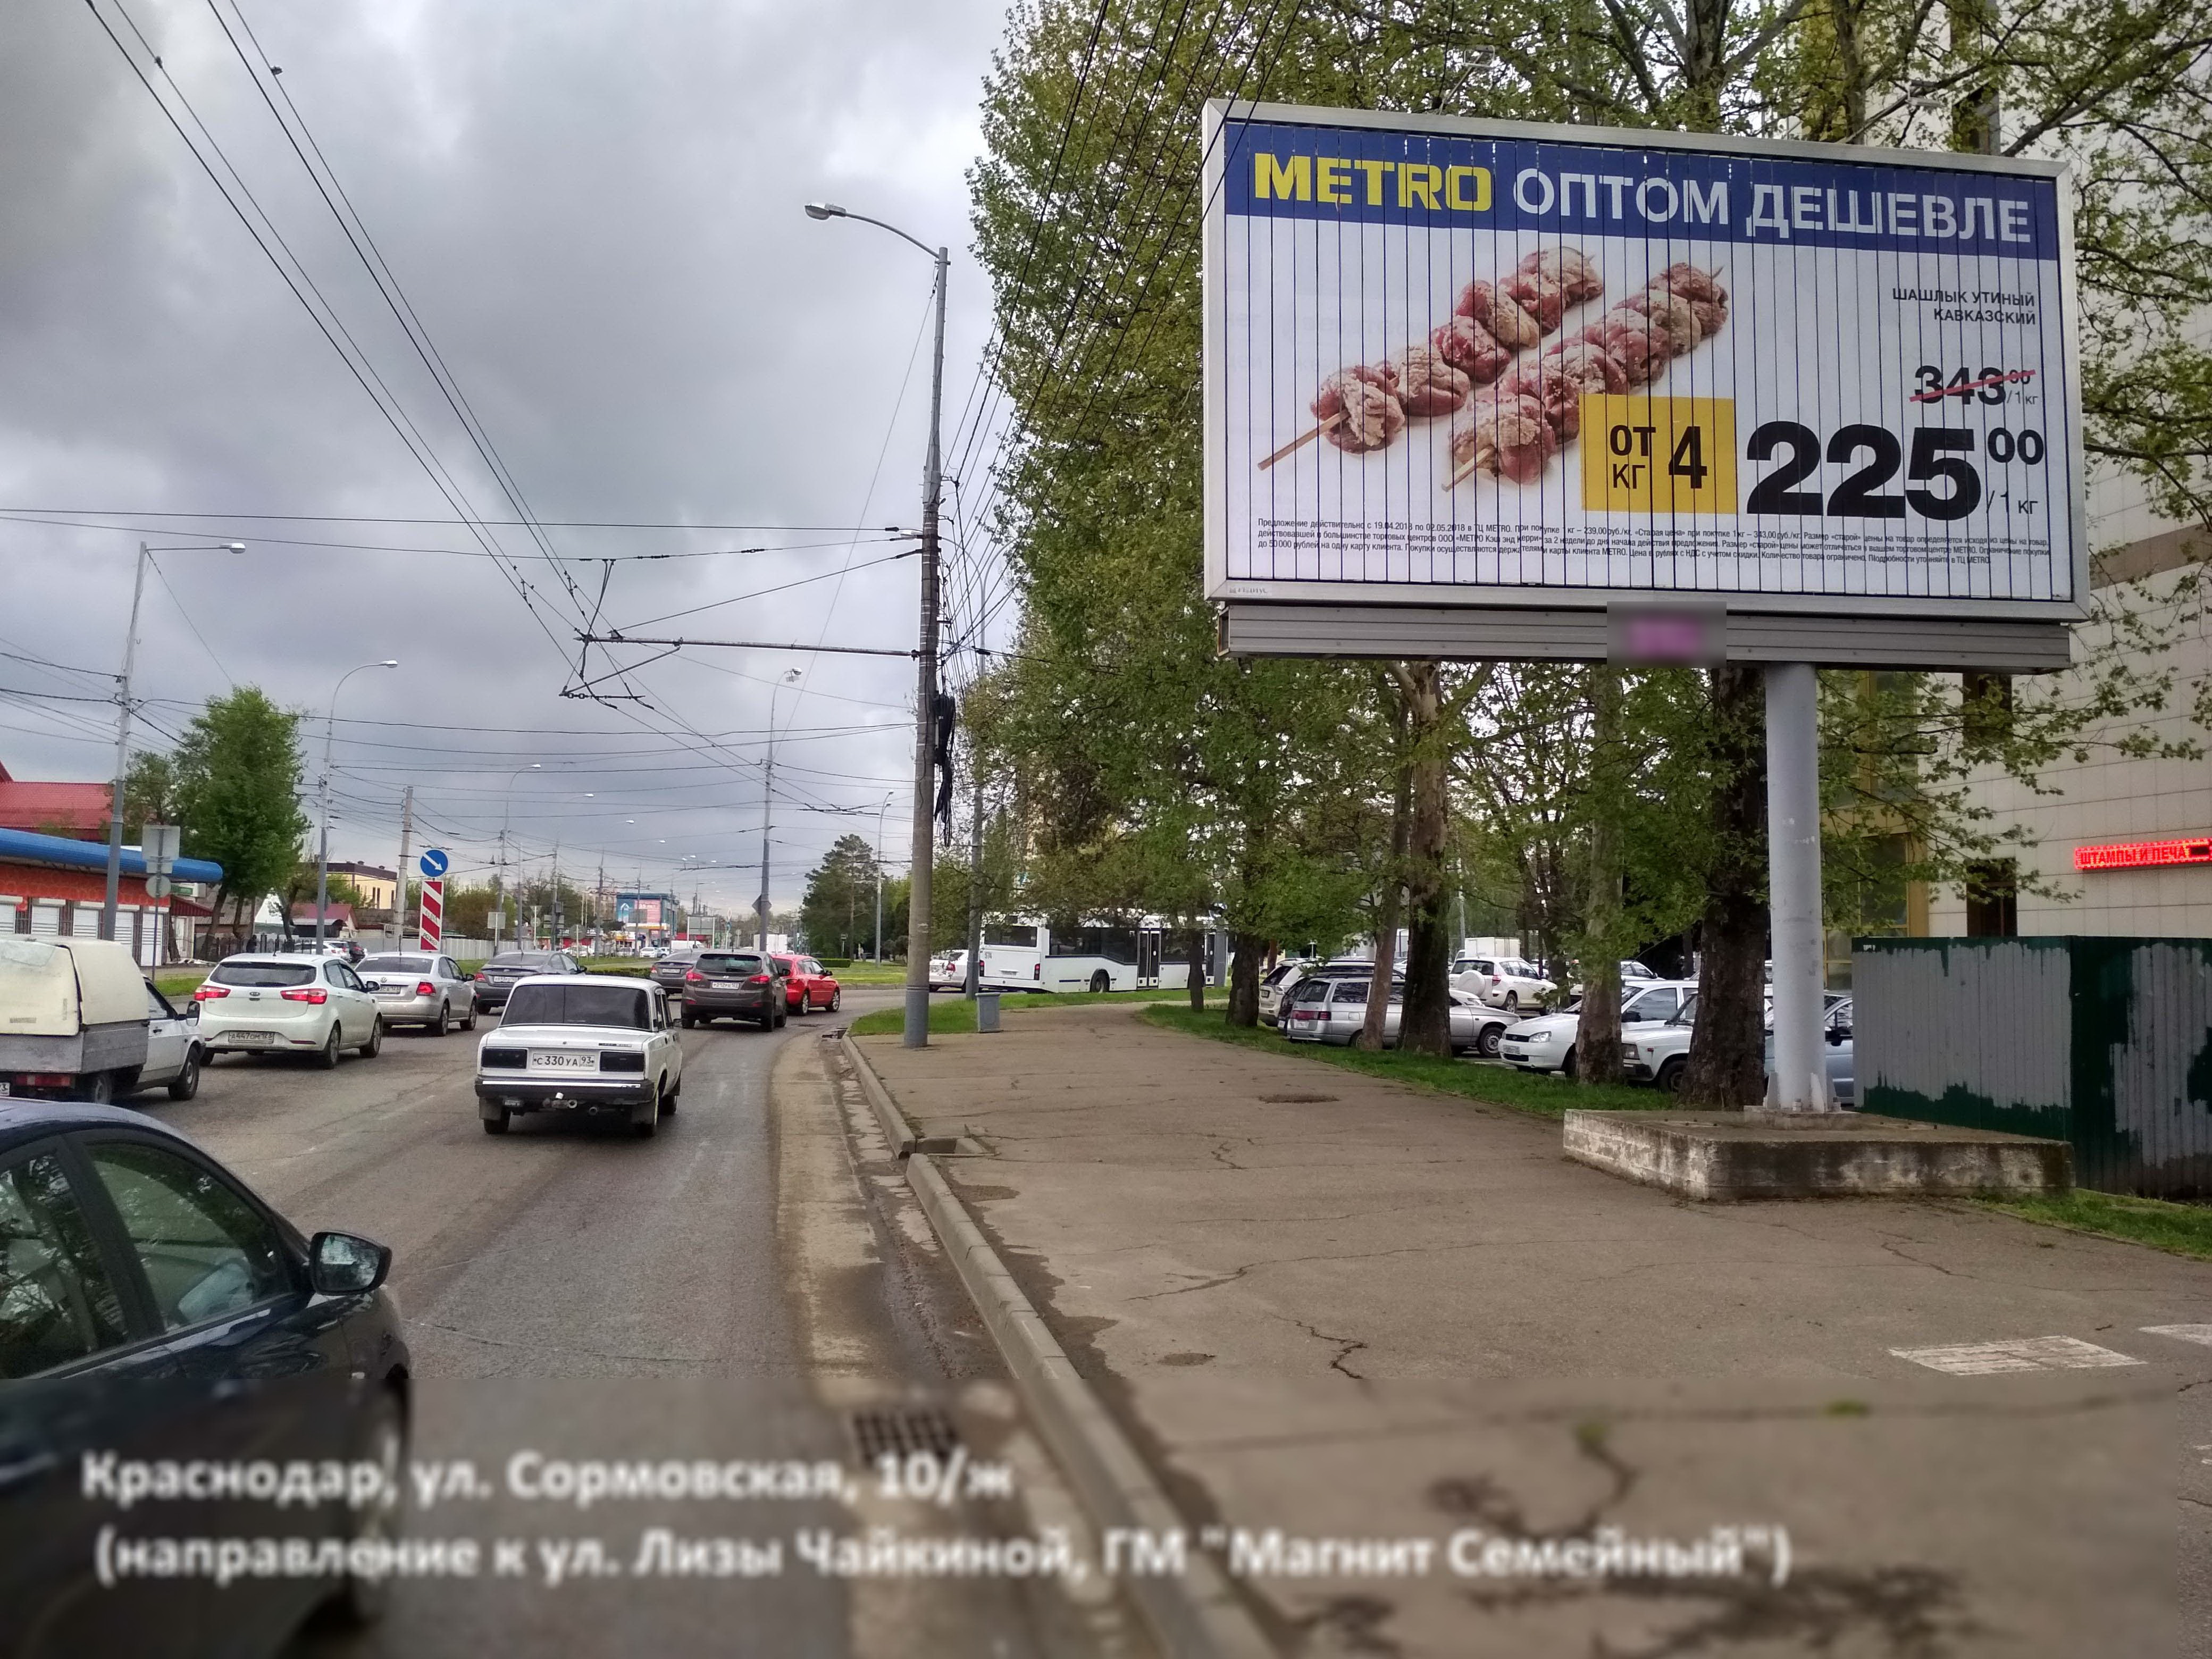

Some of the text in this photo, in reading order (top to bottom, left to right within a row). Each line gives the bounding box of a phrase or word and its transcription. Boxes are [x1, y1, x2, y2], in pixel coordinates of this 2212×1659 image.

[1254, 152, 2031, 243] METRO ОПТОМ ДЕШЕВЛЕ
[1892, 288, 2034, 307] ШАШЛЫК УТИНЫЙ
[1934, 308, 2036, 325] КАВКАЗСКИЙ
[1610, 424, 1656, 457] ОТ
[1669, 425, 1708, 489] 4
[1613, 464, 1646, 489] КГ
[1747, 421, 2045, 521] 225 00
[1258, 518, 1308, 527] Предложение
[1310, 520, 1364, 529] действительно
[1474, 525, 1484, 533] ТЦ
[1531, 524, 1559, 534] покупке
[1258, 529, 1314, 538] действовавшей
[1323, 531, 1371, 539] большинстве
[1638, 538, 1670, 547] действия
[1722, 540, 1747, 549] Размер
[1749, 541, 1779, 550] «старой»
[1979, 547, 2022, 556] Ограничение
[1294, 540, 1319, 549] рублей
[1351, 543, 1370, 552] карту
[1405, 543, 1435, 552] Покупки
[1437, 544, 1496, 555] осуществляются
[1498, 545, 1547, 555] держателями
[1630, 549, 1647, 557] Цена
[1655, 549, 1678, 558] рублях
[1686, 549, 1700, 558] НДС
[2080, 849, 2136, 865] ШТАМПЫ
[2140, 848, 2148, 861] И
